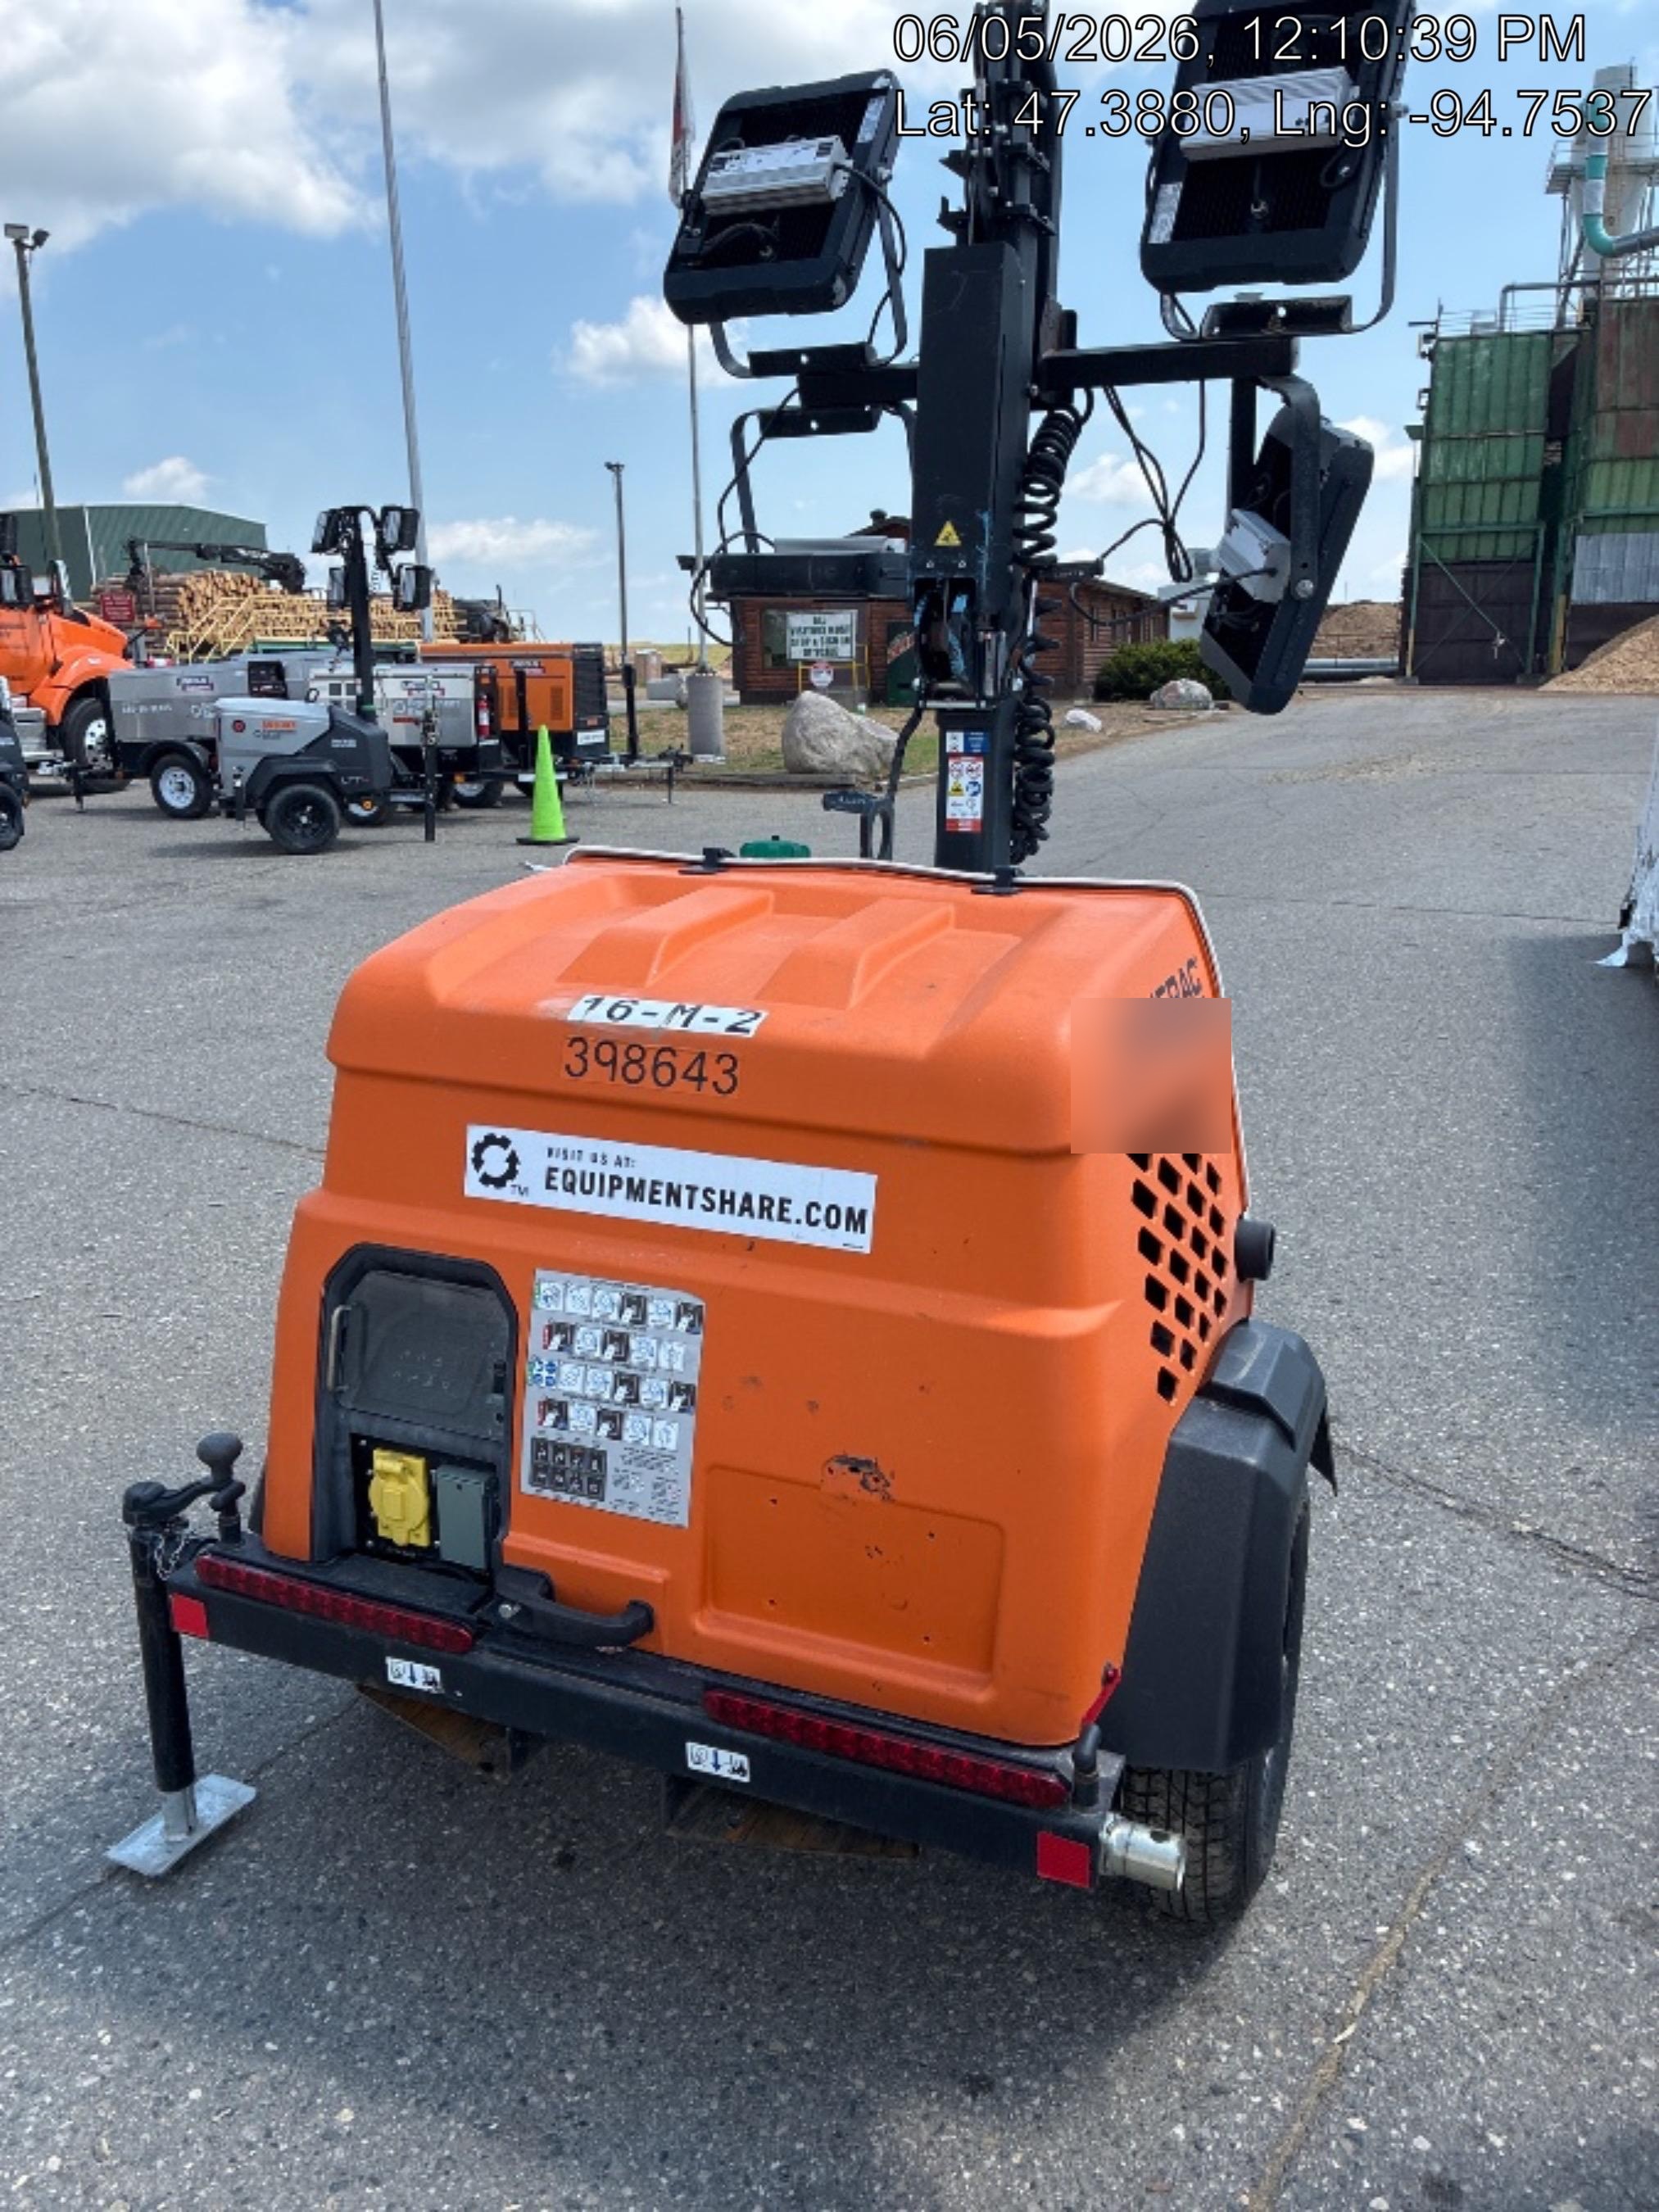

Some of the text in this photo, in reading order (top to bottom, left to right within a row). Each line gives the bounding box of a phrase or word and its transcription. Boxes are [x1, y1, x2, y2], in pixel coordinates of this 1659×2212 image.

[582, 997, 762, 1034] 16-M-2
[564, 1036, 739, 1095] 398643
[547, 1147, 583, 1162] VISIT
[545, 1167, 868, 1235] EQUIPMENTSHARE.COM
